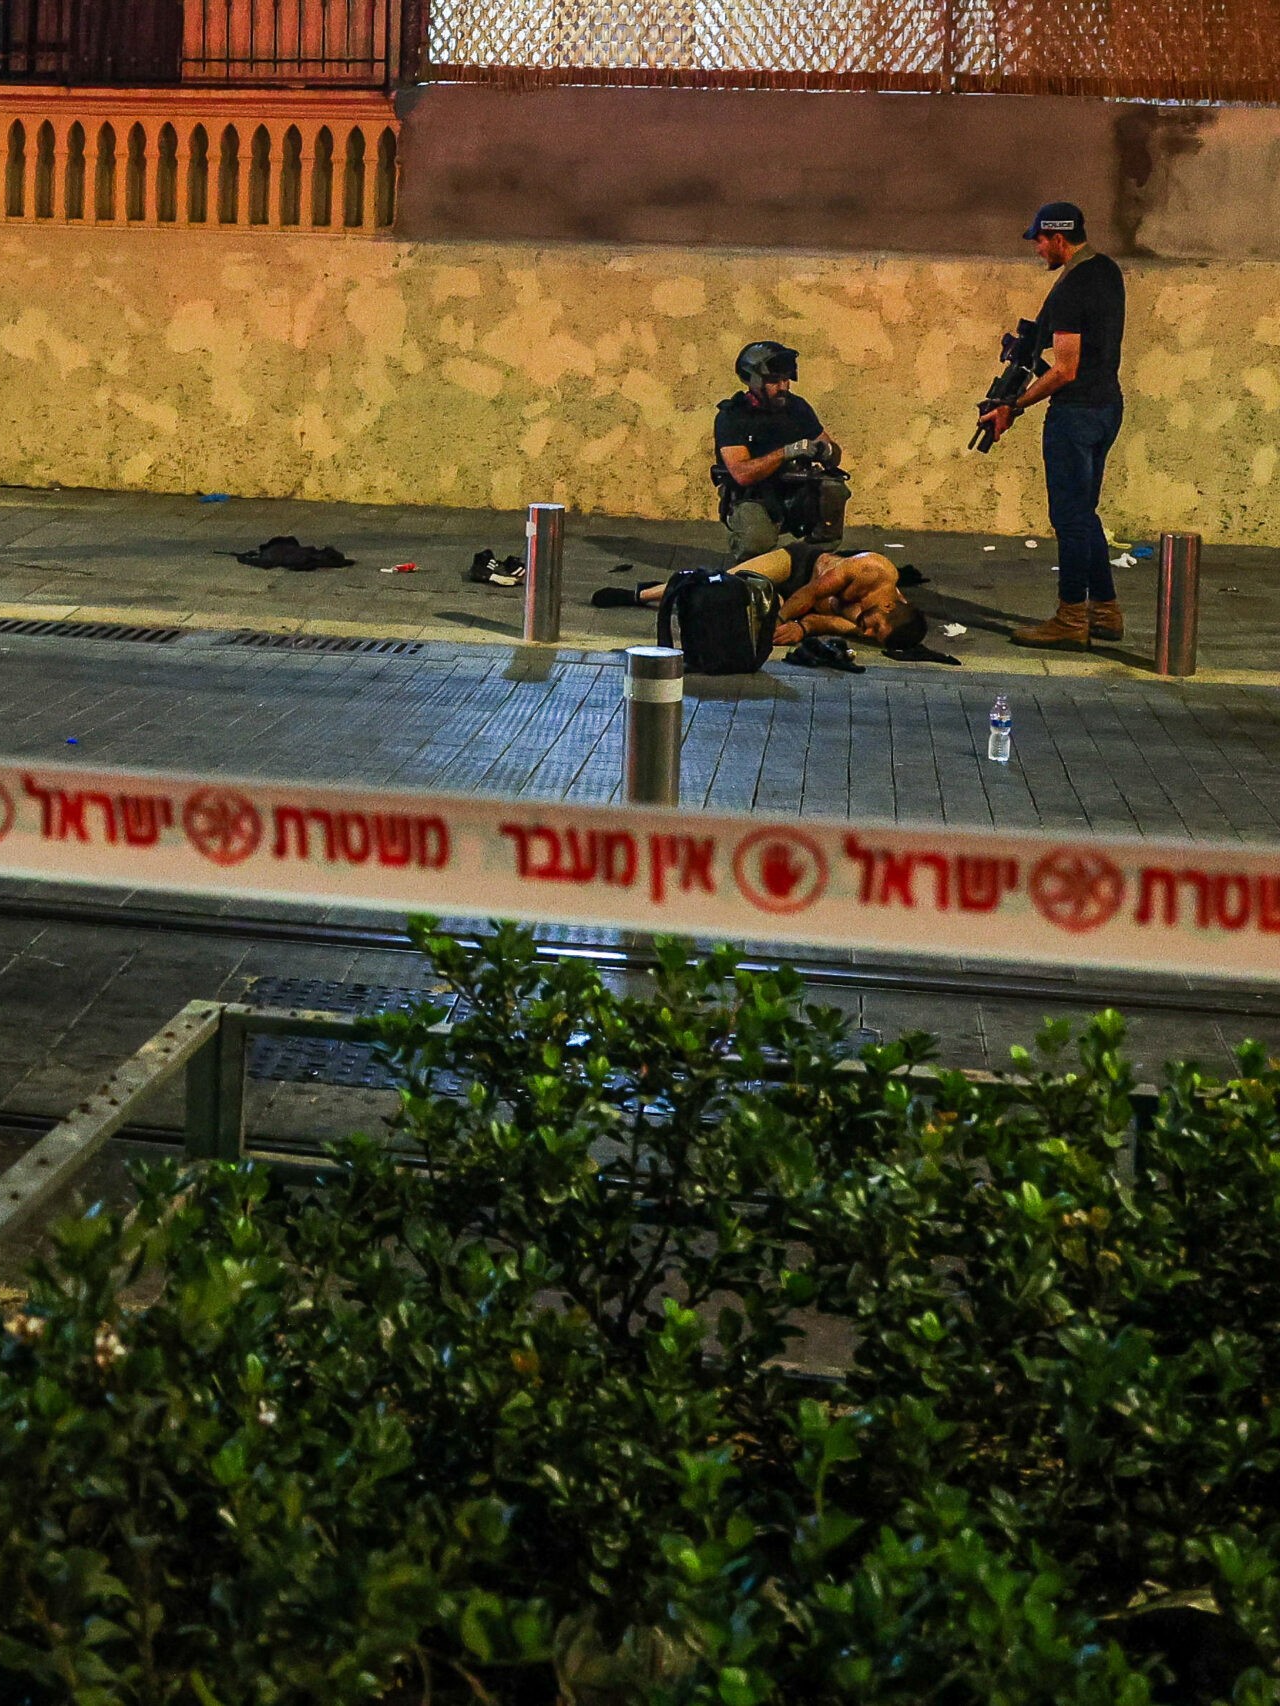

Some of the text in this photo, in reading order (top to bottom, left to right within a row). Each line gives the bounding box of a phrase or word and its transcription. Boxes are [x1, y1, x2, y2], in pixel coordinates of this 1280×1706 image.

[23, 775, 173, 848] ישראל
[274, 806, 450, 869] משטרת
[502, 823, 637, 886] מעבר
[649, 834, 715, 904] אין
[846, 835, 1019, 911] ישראל
